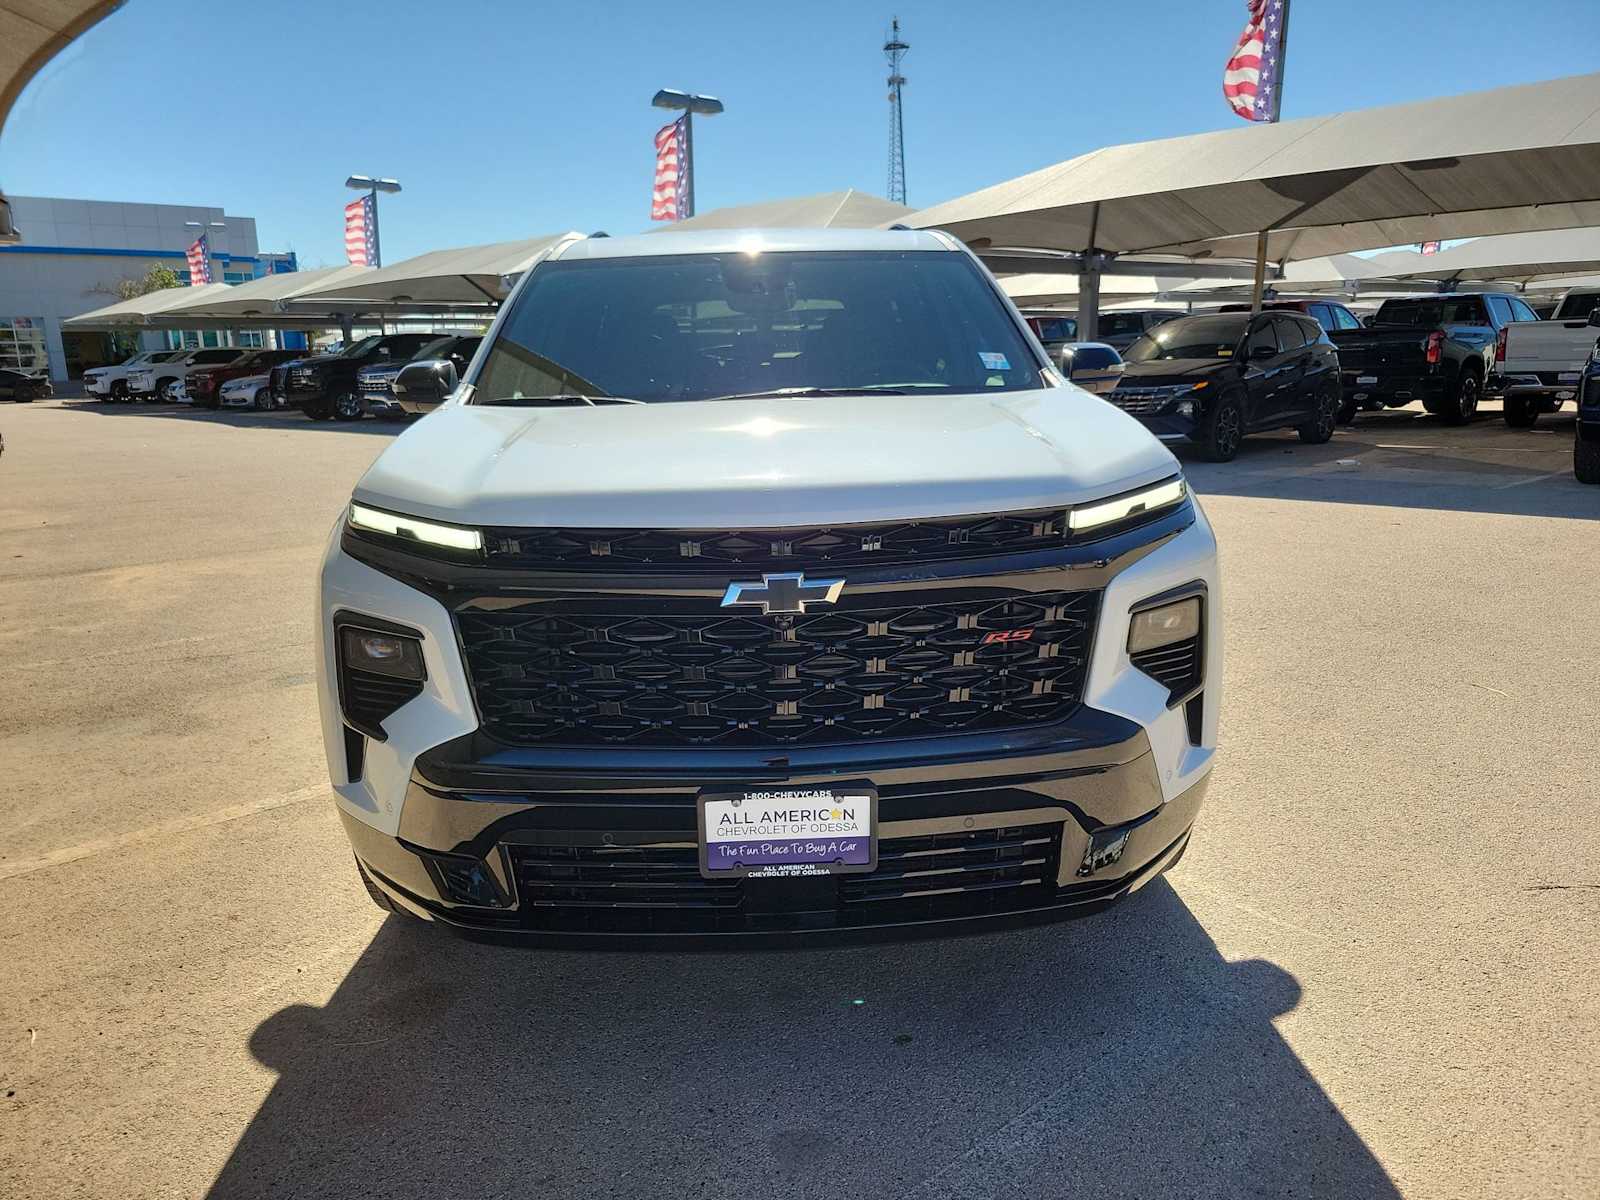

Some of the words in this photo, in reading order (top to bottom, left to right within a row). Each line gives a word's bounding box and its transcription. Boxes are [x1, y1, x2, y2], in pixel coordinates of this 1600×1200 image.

[981, 628, 1034, 644] RS
[743, 790, 832, 801] 1-800-CHEVYCARS
[719, 812, 754, 825] ALL
[760, 808, 855, 823] AMERICN
[717, 824, 787, 836] CHEVROLET
[791, 823, 807, 834] OF
[810, 822, 859, 833] ODESSA
[718, 845, 738, 857] The
[739, 844, 759, 856] Fun
[761, 843, 789, 855] Place
[790, 842, 804, 854] To
[804, 842, 826, 856] Buy
[827, 842, 838, 853] A
[839, 841, 857, 852] Car
[748, 870, 788, 878] CHEVROLET
